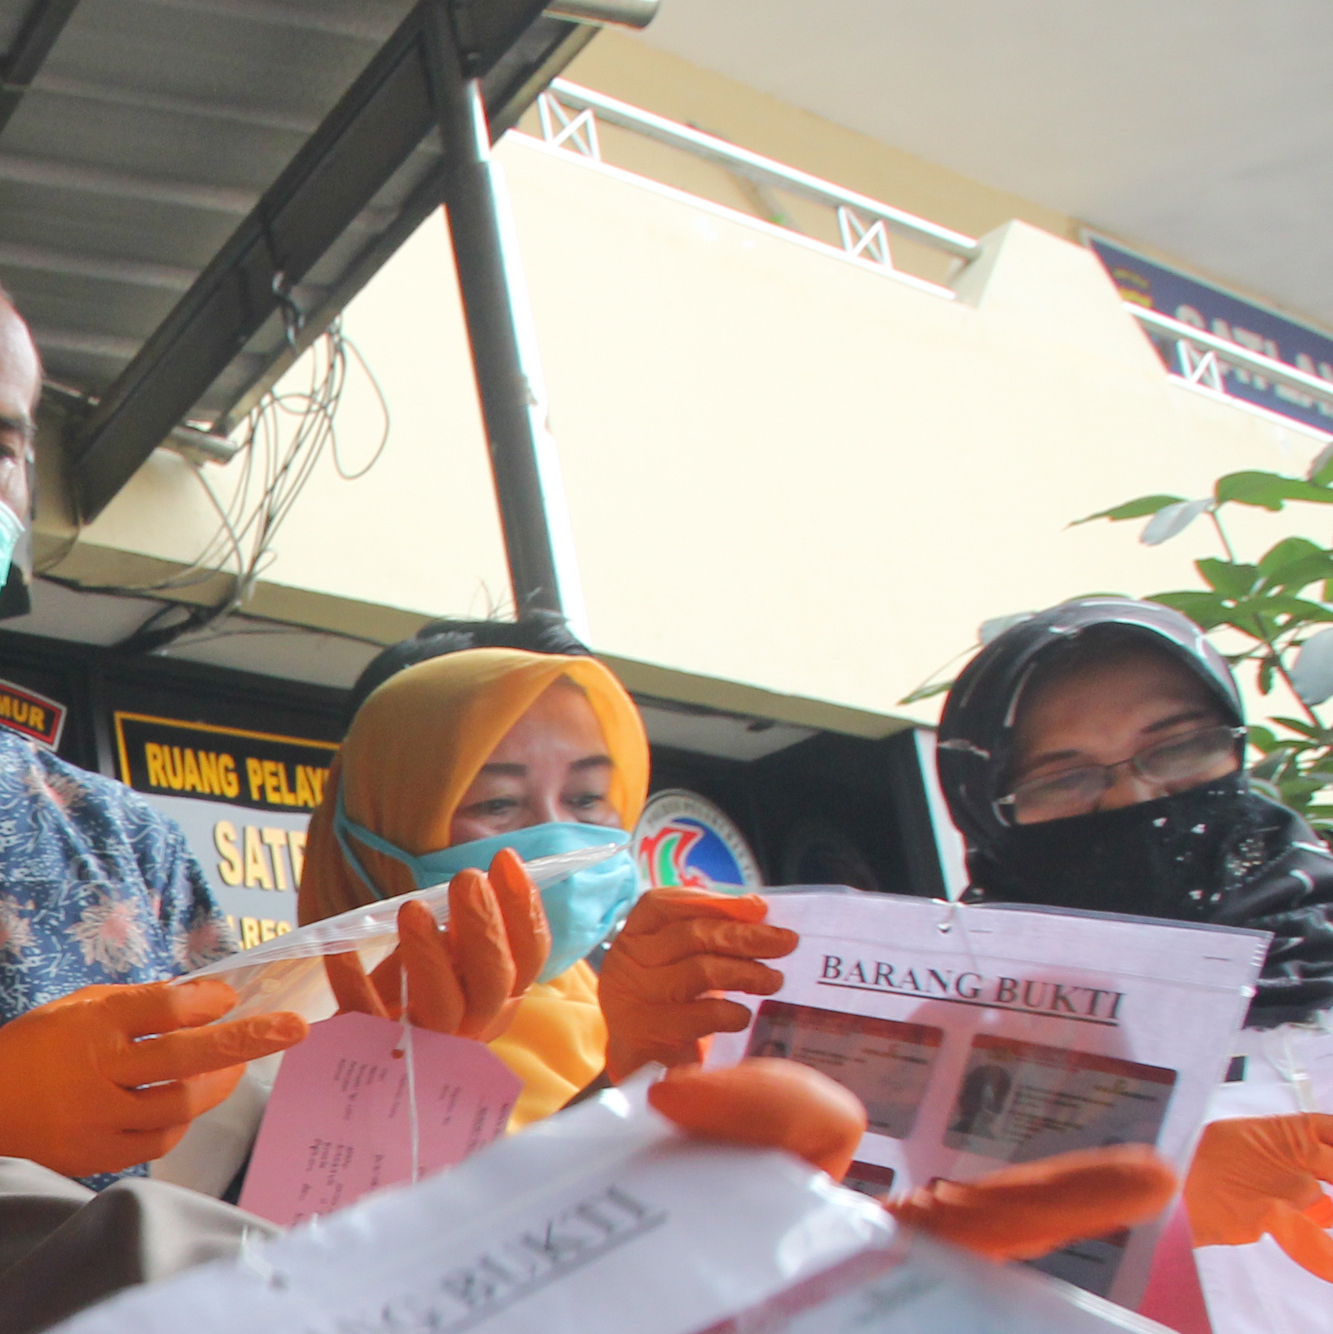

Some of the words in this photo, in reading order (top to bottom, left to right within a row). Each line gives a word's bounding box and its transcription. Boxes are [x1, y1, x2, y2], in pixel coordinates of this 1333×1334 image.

[144, 743, 238, 799] RUANG
[245, 758, 329, 808] PELAY
[820, 955, 983, 1000] BARANG
[996, 976, 1127, 1020] BUKTI
